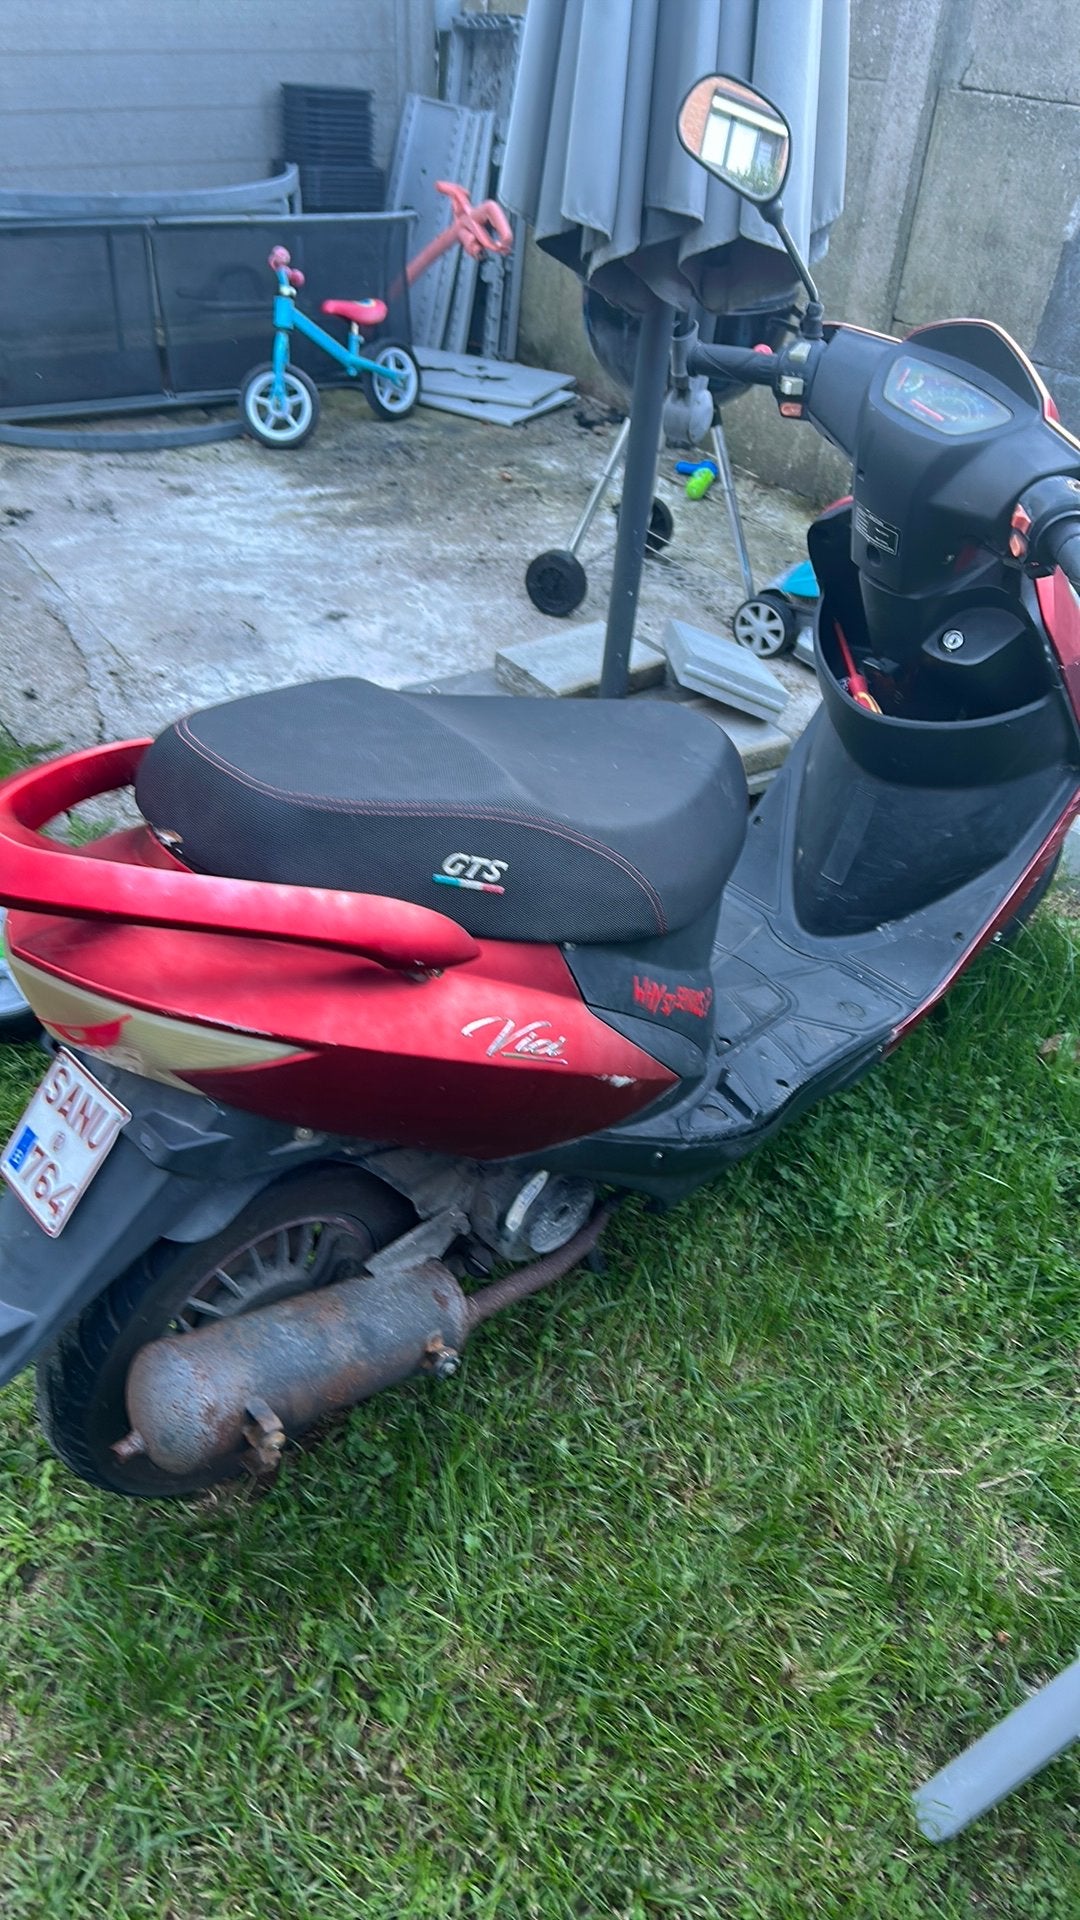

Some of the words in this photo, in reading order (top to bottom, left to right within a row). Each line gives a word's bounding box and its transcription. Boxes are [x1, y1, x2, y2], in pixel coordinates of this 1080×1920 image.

[441, 851, 509, 883] GTS
[43, 1067, 116, 1150] SANU
[20, 1143, 77, 1218] 764
